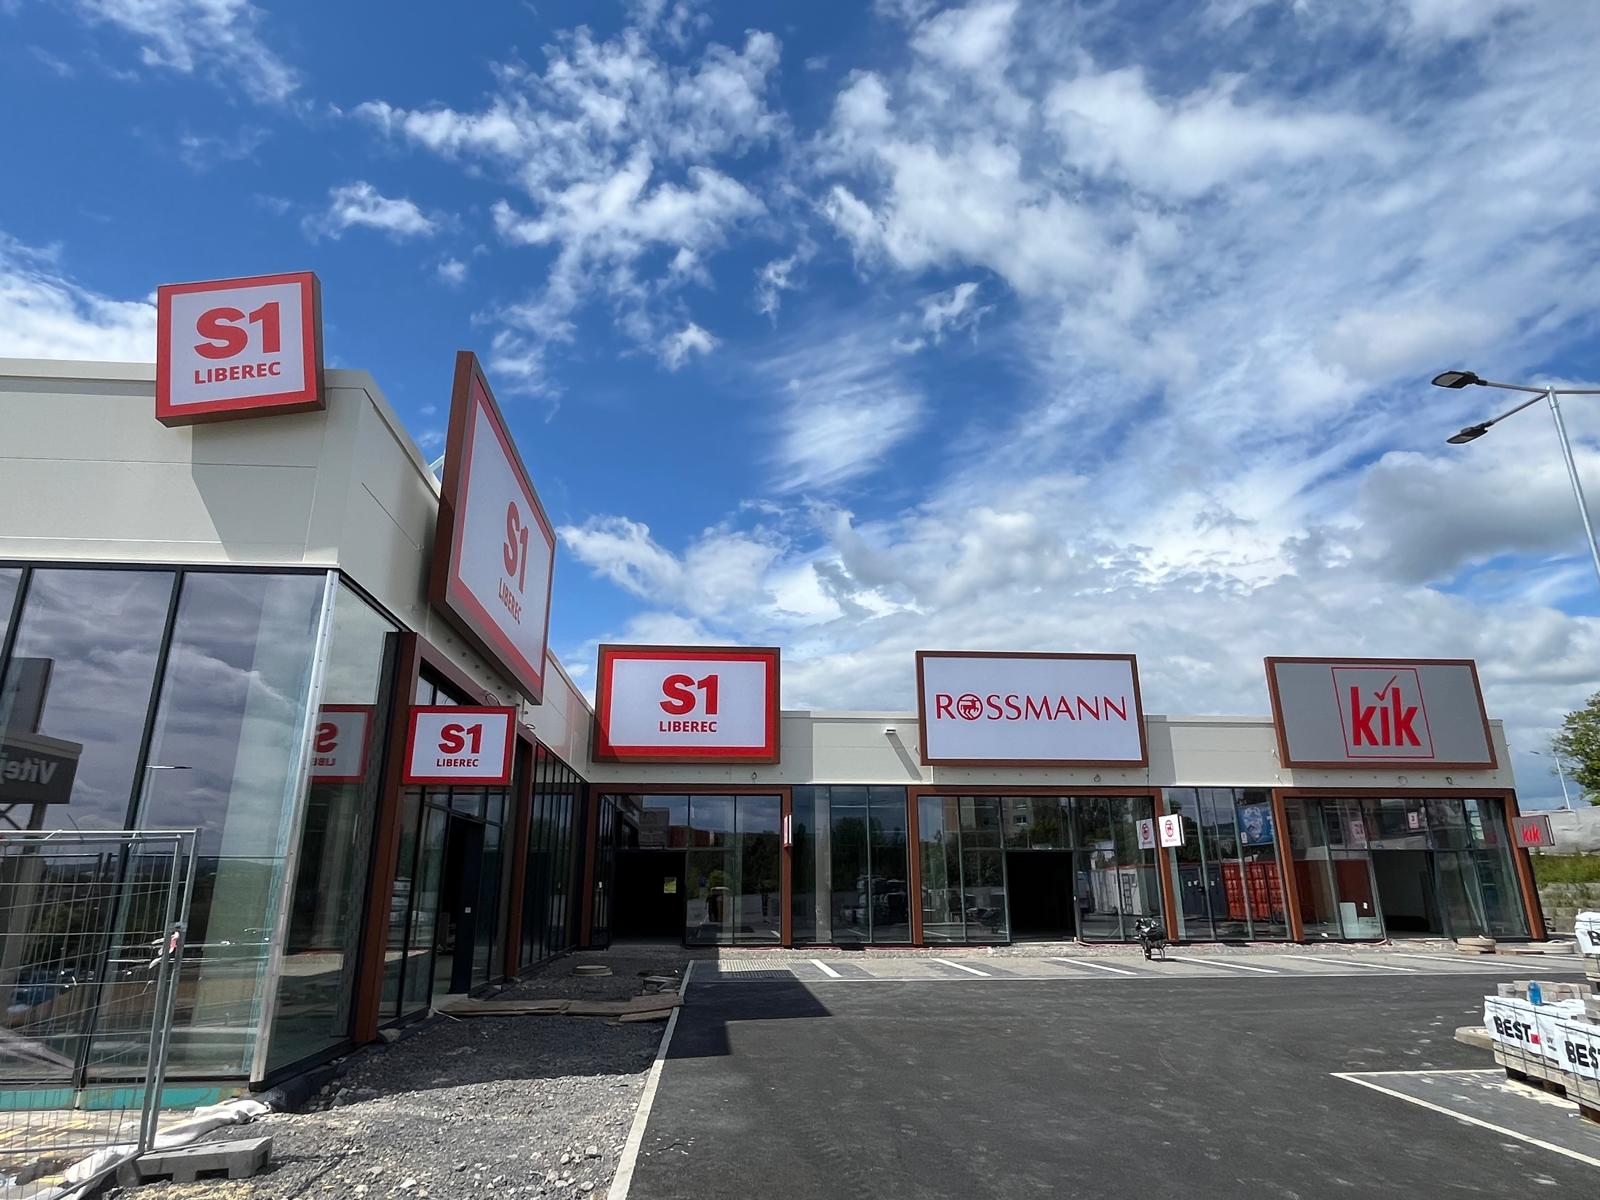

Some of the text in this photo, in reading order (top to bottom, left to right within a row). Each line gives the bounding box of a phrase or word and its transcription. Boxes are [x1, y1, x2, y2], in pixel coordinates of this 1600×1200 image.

[194, 302, 281, 360] S1
[194, 361, 281, 385] LIBEREC
[503, 501, 528, 594] S1
[499, 577, 521, 625] LIBEREC
[660, 674, 719, 715] S1
[935, 694, 1128, 721] ROSSMANN
[659, 720, 718, 732] LIBEREC
[1350, 676, 1422, 746] kik
[438, 723, 483, 754] S1
[436, 758, 479, 767] LIBEREC
[1564, 1040, 1600, 1069] BES
